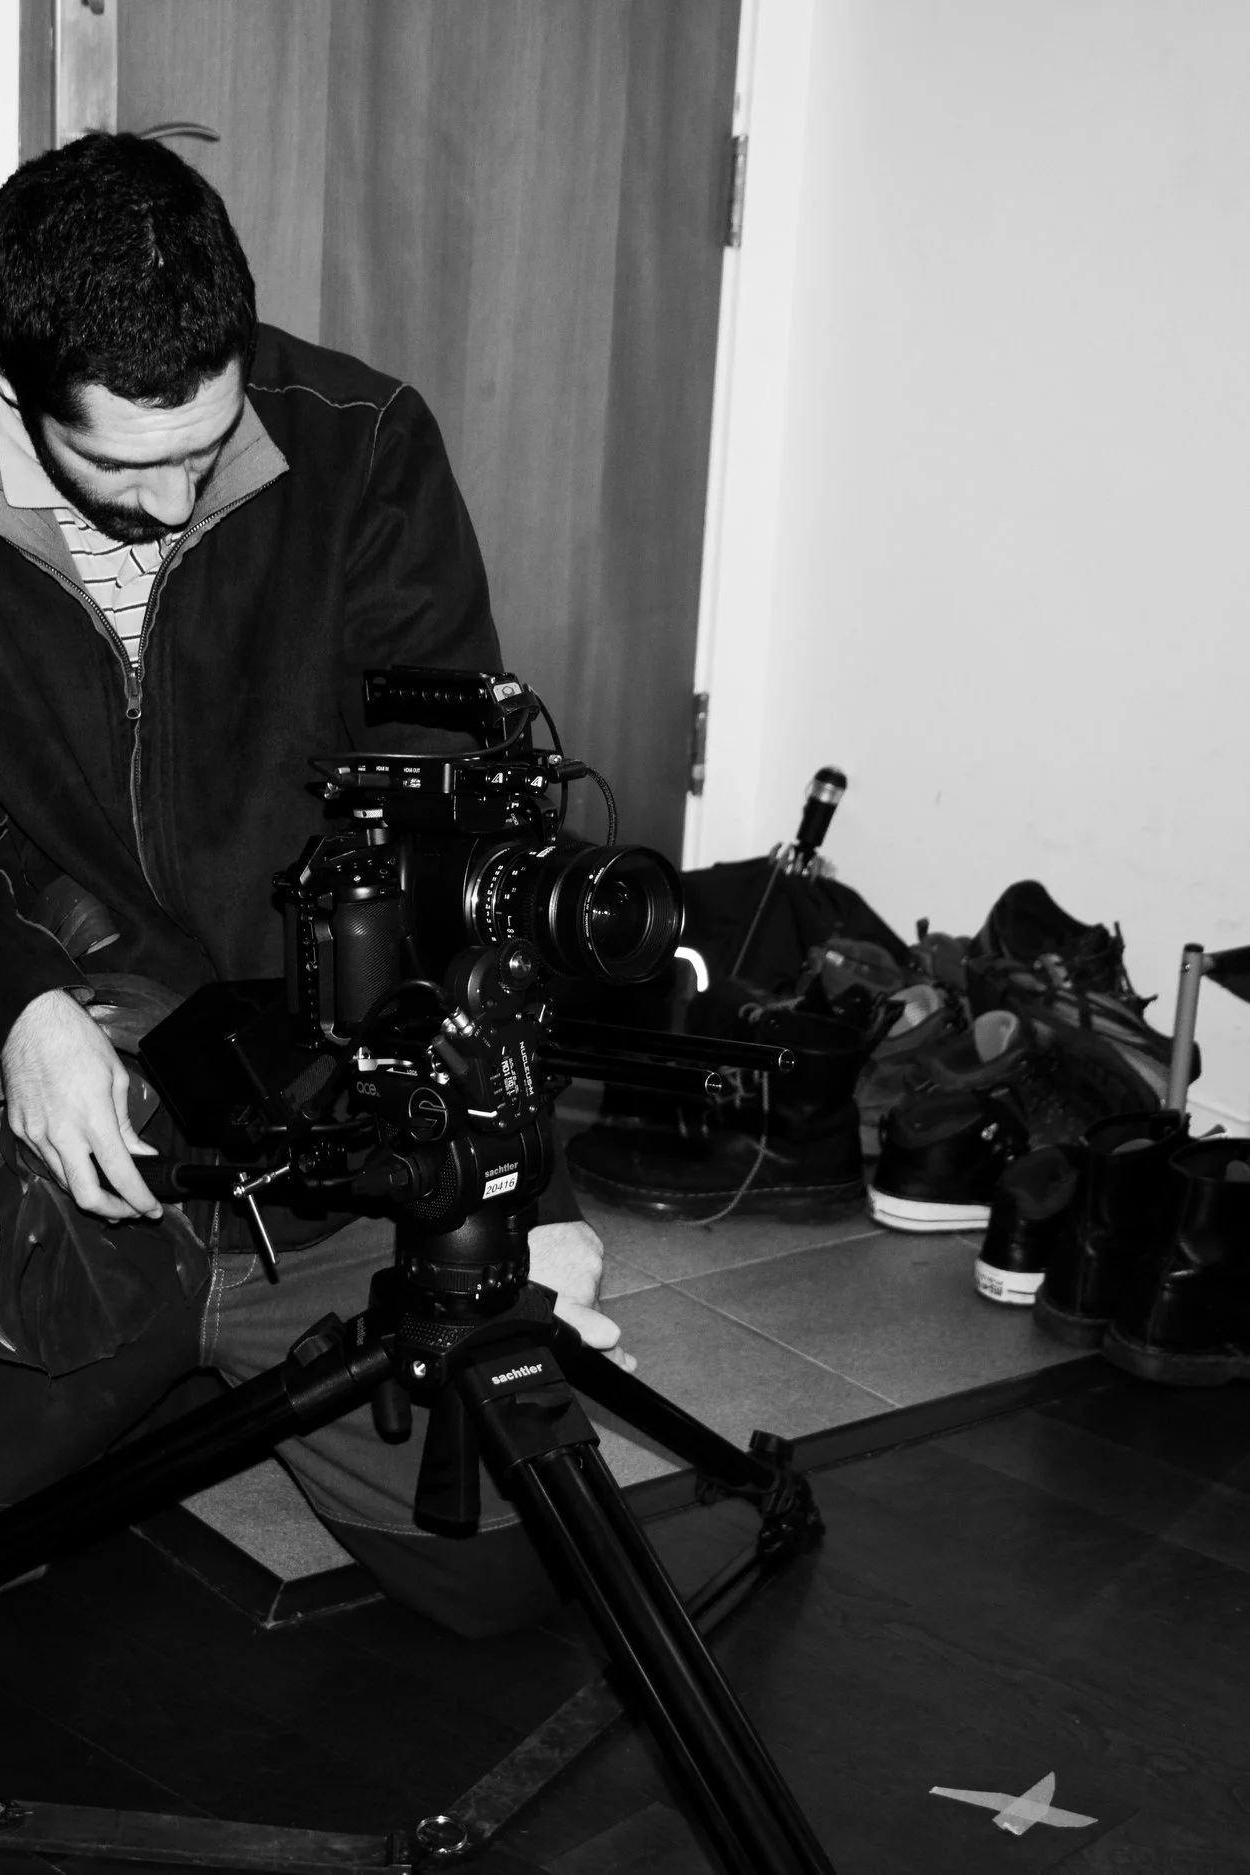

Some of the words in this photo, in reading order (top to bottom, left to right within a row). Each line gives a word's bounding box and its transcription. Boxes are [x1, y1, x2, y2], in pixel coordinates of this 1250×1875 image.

[519, 1041, 534, 1096] NUCLEUS-M
[484, 1161, 519, 1179] sachtler
[485, 1178, 516, 1196] 20416
[491, 1363, 543, 1385] sachtler
